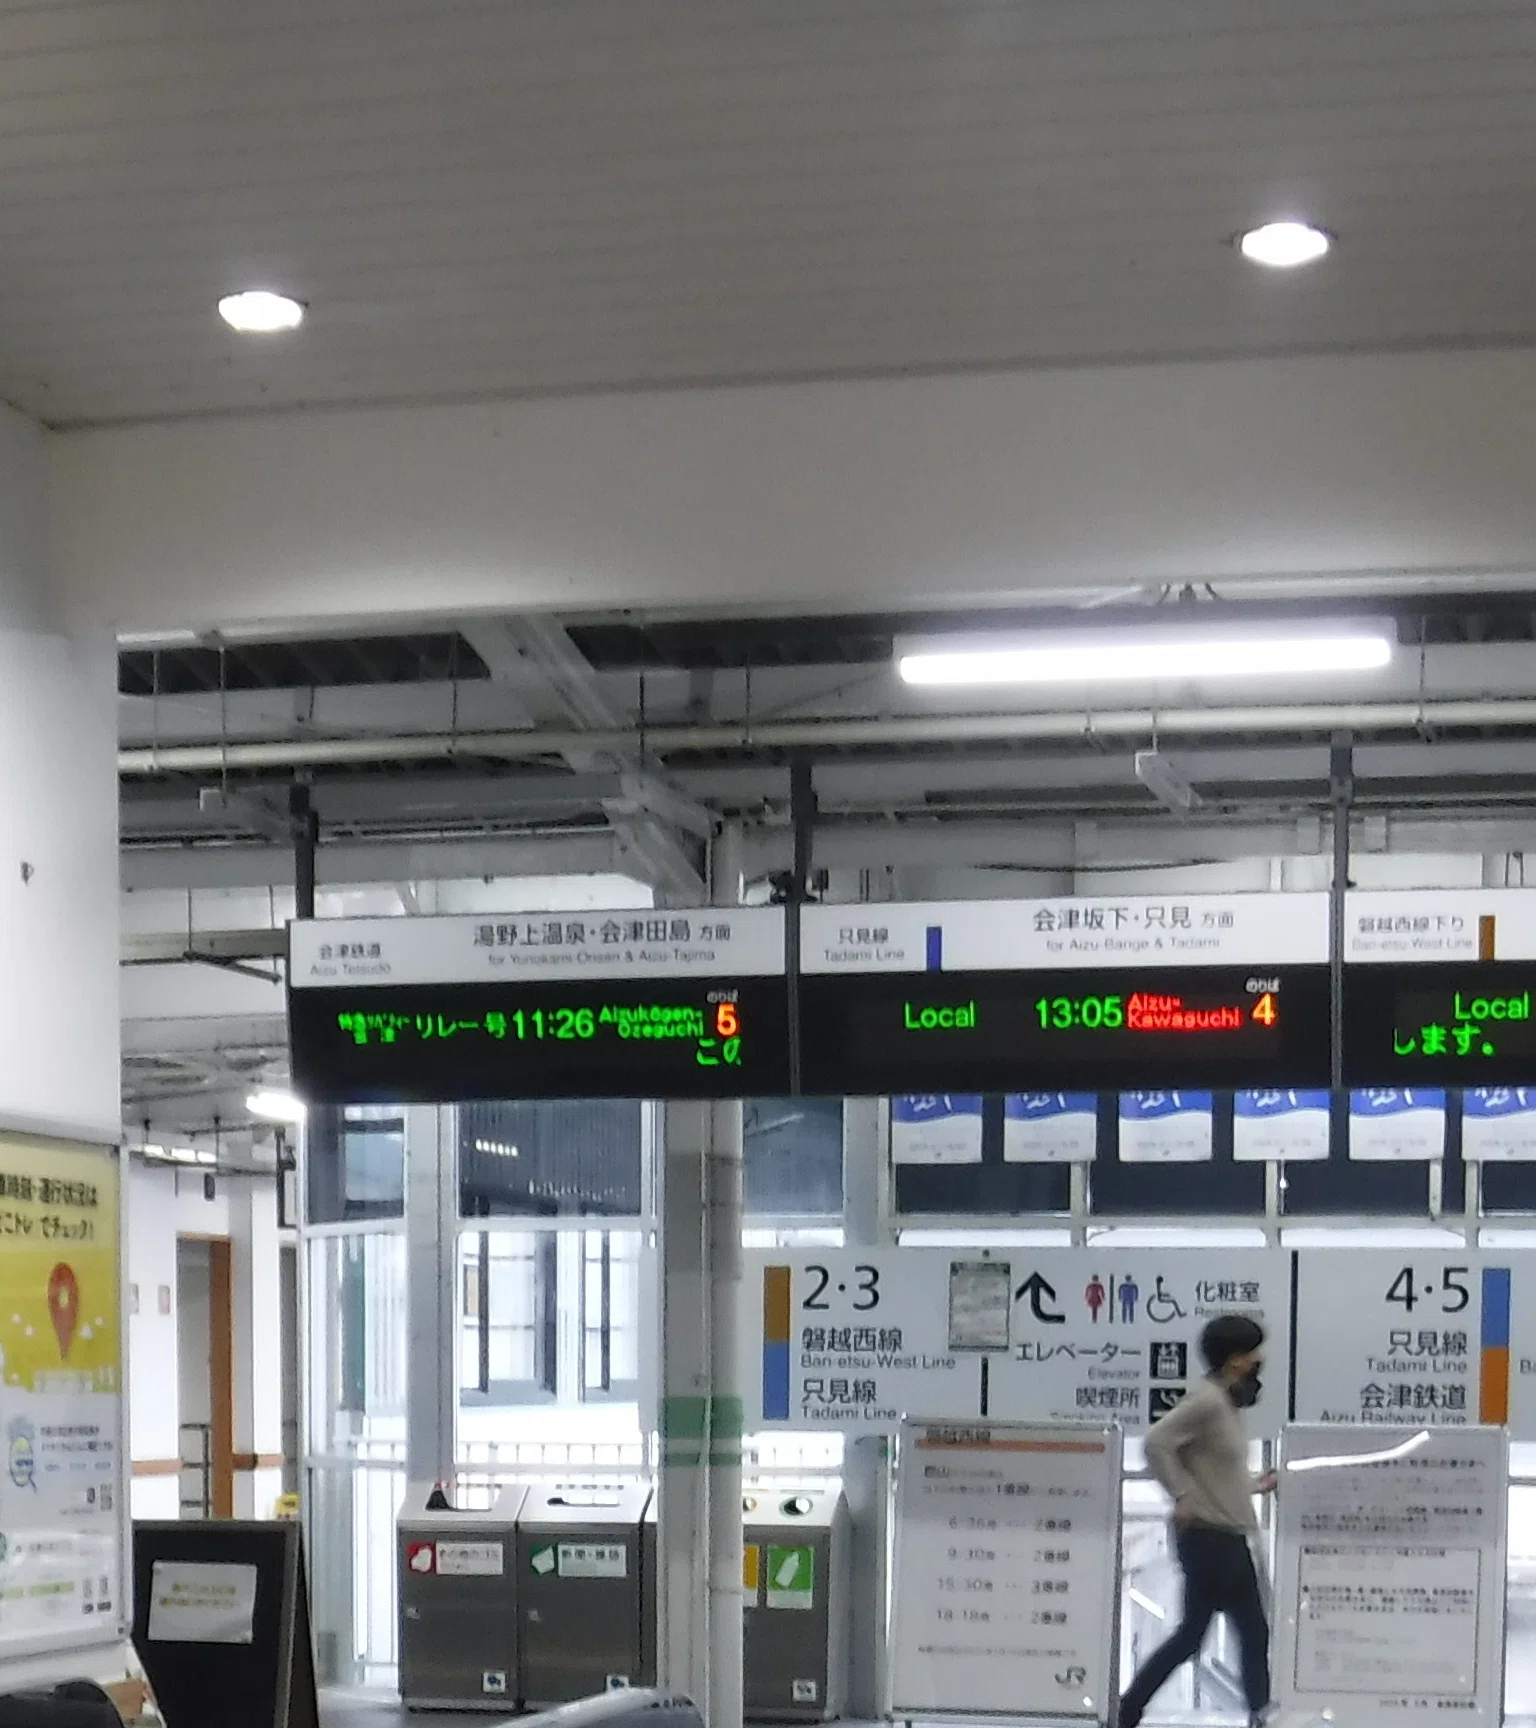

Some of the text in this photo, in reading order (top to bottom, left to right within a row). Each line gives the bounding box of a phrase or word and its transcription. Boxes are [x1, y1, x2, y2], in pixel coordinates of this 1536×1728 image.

[1033, 906, 1234, 932] 会津坂下・只見 方面
[839, 928, 889, 944] 只見線
[876, 949, 905, 961] Line
[905, 1000, 975, 1029] Local
[1035, 995, 1123, 1029] 13:05
[1252, 993, 1275, 1025] 4
[1454, 990, 1529, 1020] Local
[513, 1007, 595, 1039] 11:26
[717, 1003, 737, 1036] 5
[1127, 1007, 1241, 1029] Kawaguchi
[1394, 1022, 1494, 1055] します。
[1196, 1280, 1260, 1302] 化粧室
[802, 1326, 902, 1353] 磐越西線
[1388, 1330, 1467, 1356] 只見線
[922, 1355, 956, 1370] Line
[1015, 1342, 1141, 1362] エレベーター
[1088, 1367, 1140, 1380] Elevator
[1366, 1358, 1467, 1373] Tadami Line
[802, 1379, 877, 1404] 只見線
[1076, 1388, 1140, 1408] 喫煙所
[1360, 1383, 1465, 1409] 会津鉄道
[802, 1406, 897, 1421] Tadami Line
